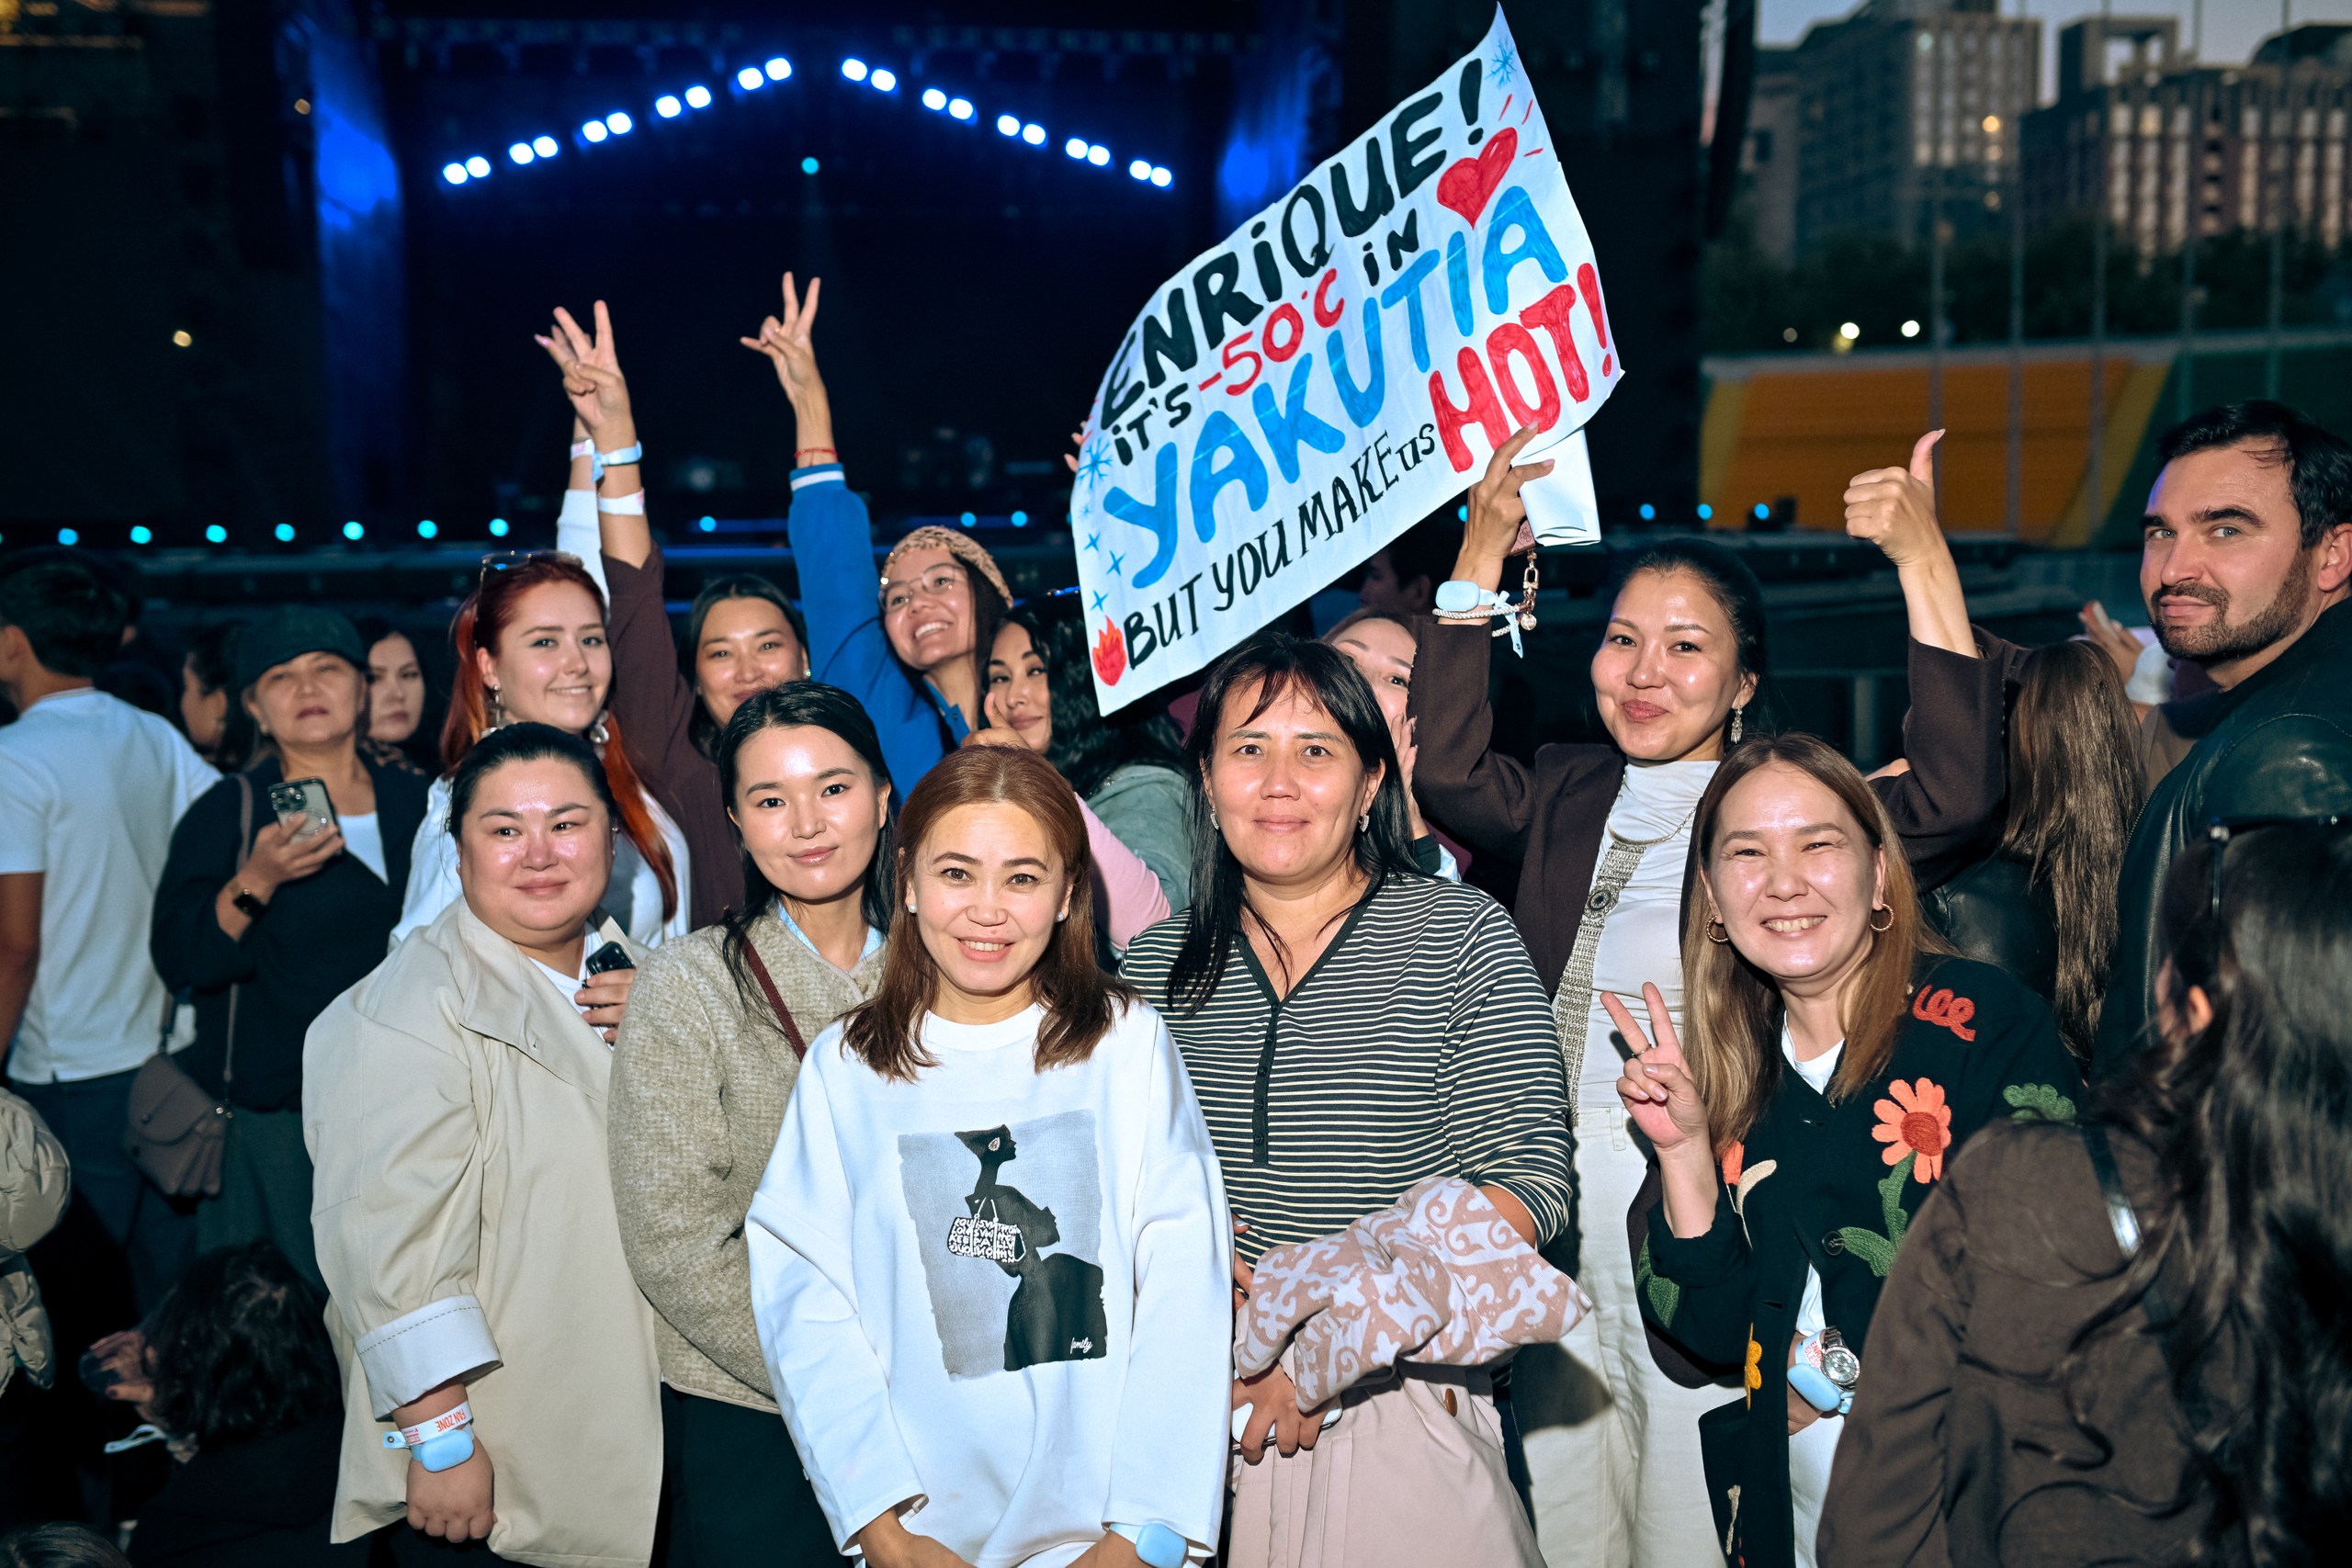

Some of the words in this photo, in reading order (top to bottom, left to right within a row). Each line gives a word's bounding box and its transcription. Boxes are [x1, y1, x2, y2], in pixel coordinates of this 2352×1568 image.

[1102, 185, 1569, 590] YAKUTIA
[1124, 572, 1205, 671] BUT
[1212, 517, 1294, 612] YOU
[1297, 429, 1400, 558] MAKE
[1429, 263, 1613, 474] HOT!
[1810, 1341, 1823, 1360] ENRI
[435, 1416, 454, 1431] ZONE
[454, 1409, 466, 1423] FAN
